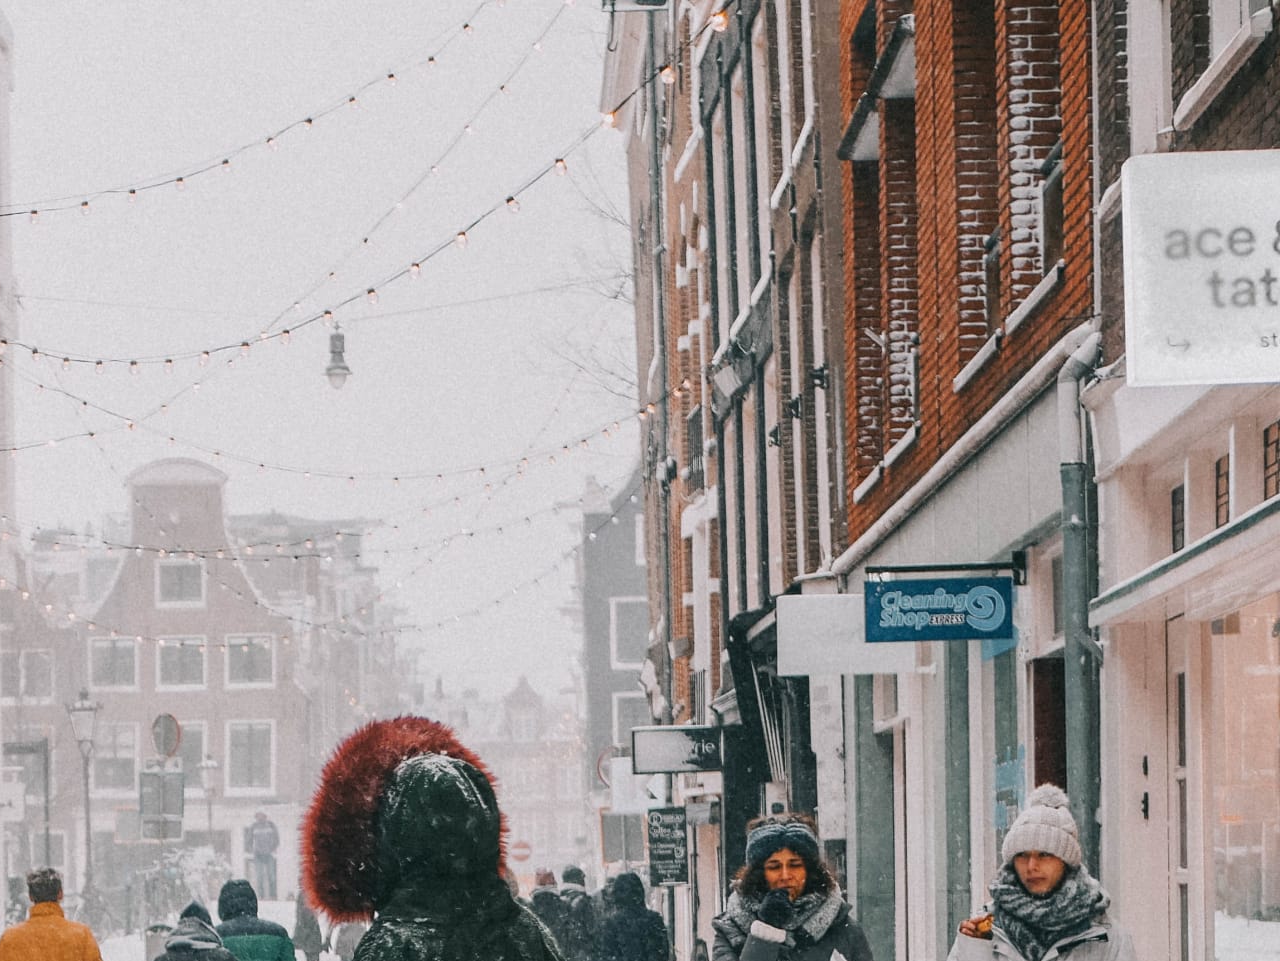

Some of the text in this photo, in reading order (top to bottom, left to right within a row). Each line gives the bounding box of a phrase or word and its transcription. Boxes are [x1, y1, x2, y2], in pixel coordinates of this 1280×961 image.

[1165, 227, 1256, 259] ace
[1207, 268, 1278, 308] tat
[1260, 332, 1279, 348] st
[880, 587, 969, 613] Cleaning
[880, 607, 966, 631] Shop EXPRESS
